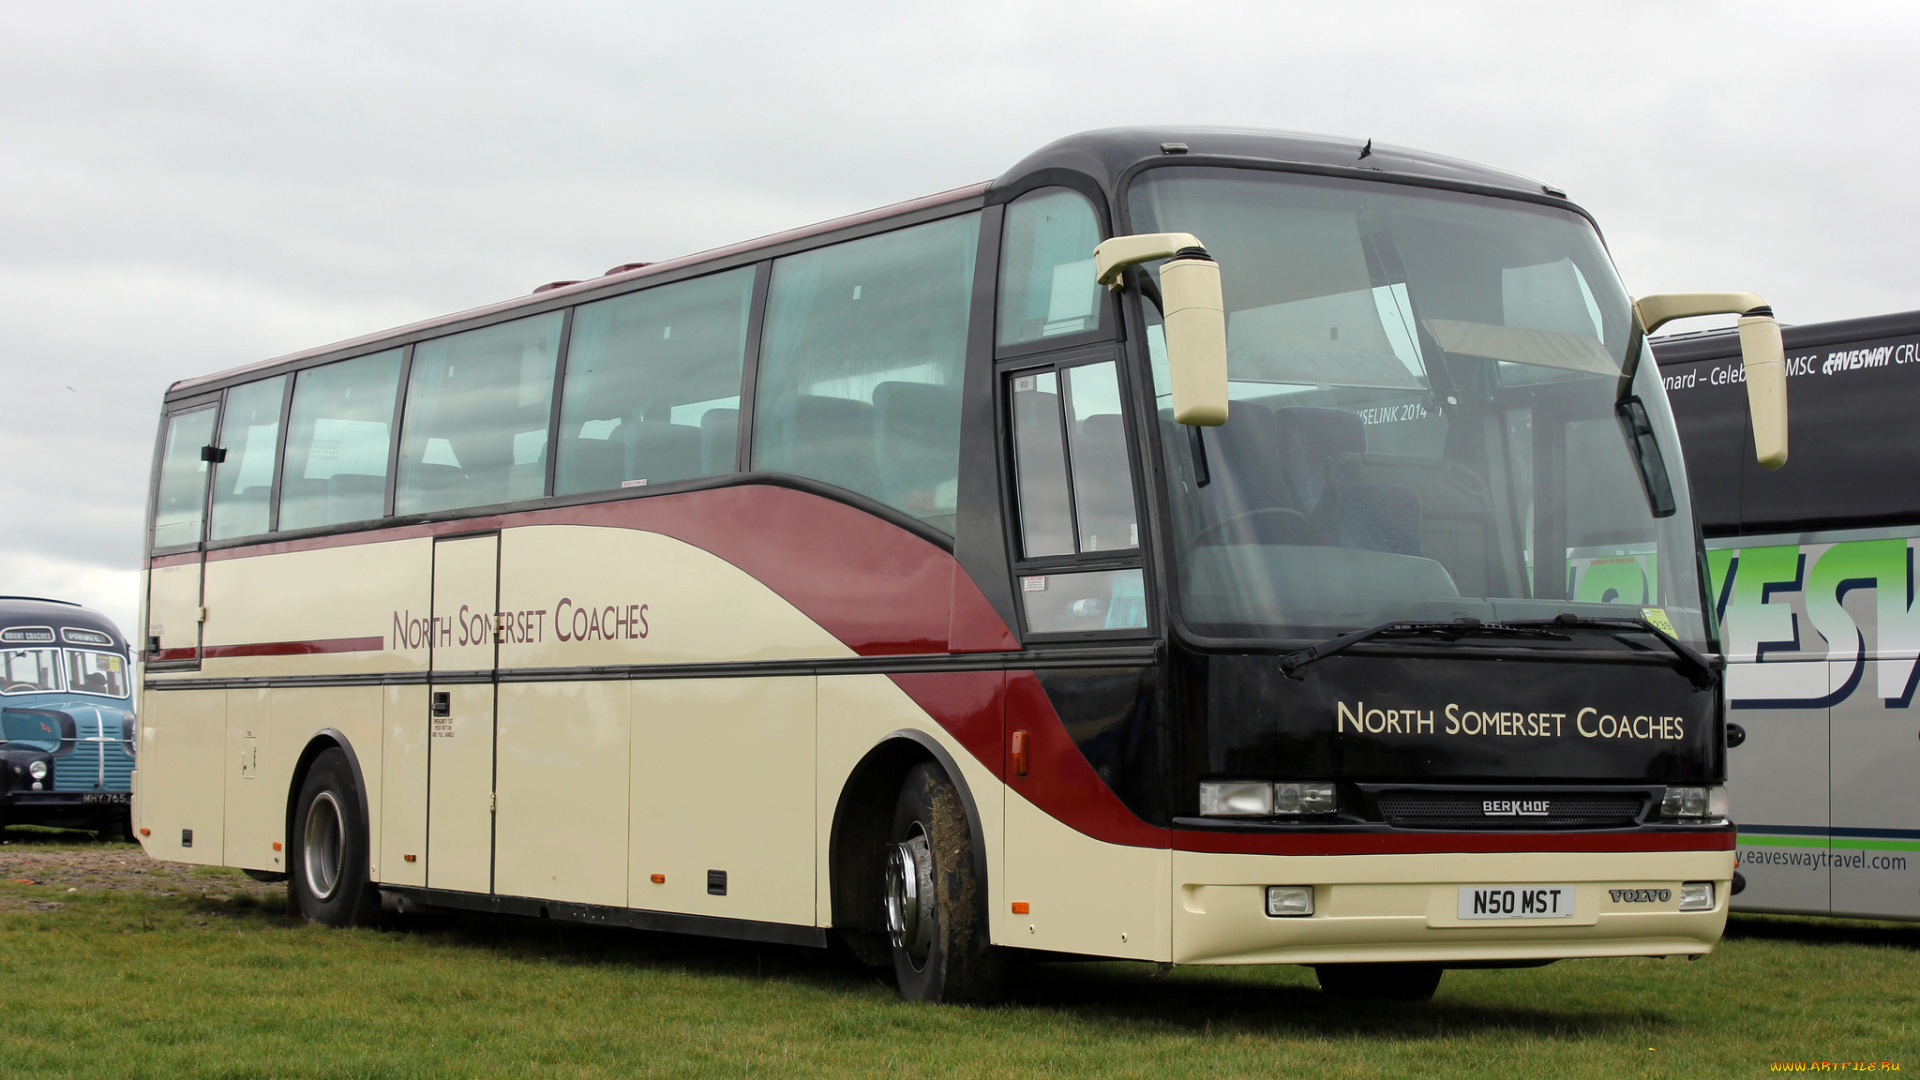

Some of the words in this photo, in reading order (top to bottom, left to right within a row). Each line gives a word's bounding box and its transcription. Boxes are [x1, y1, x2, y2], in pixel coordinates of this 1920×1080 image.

[1785, 354, 1818, 377] MSC
[1400, 403, 1427, 421] 2014
[392, 609, 452, 651] NORTH
[554, 597, 649, 643] COACHES
[1337, 701, 1434, 735] NORTH
[1444, 703, 1567, 738] SOMERSET
[1576, 707, 1684, 740] COACHES
[1482, 800, 1550, 816] BERKHOF
[1473, 890, 1515, 915] N50
[1521, 889, 1562, 914] MST
[1609, 888, 1673, 904] VOLVO
